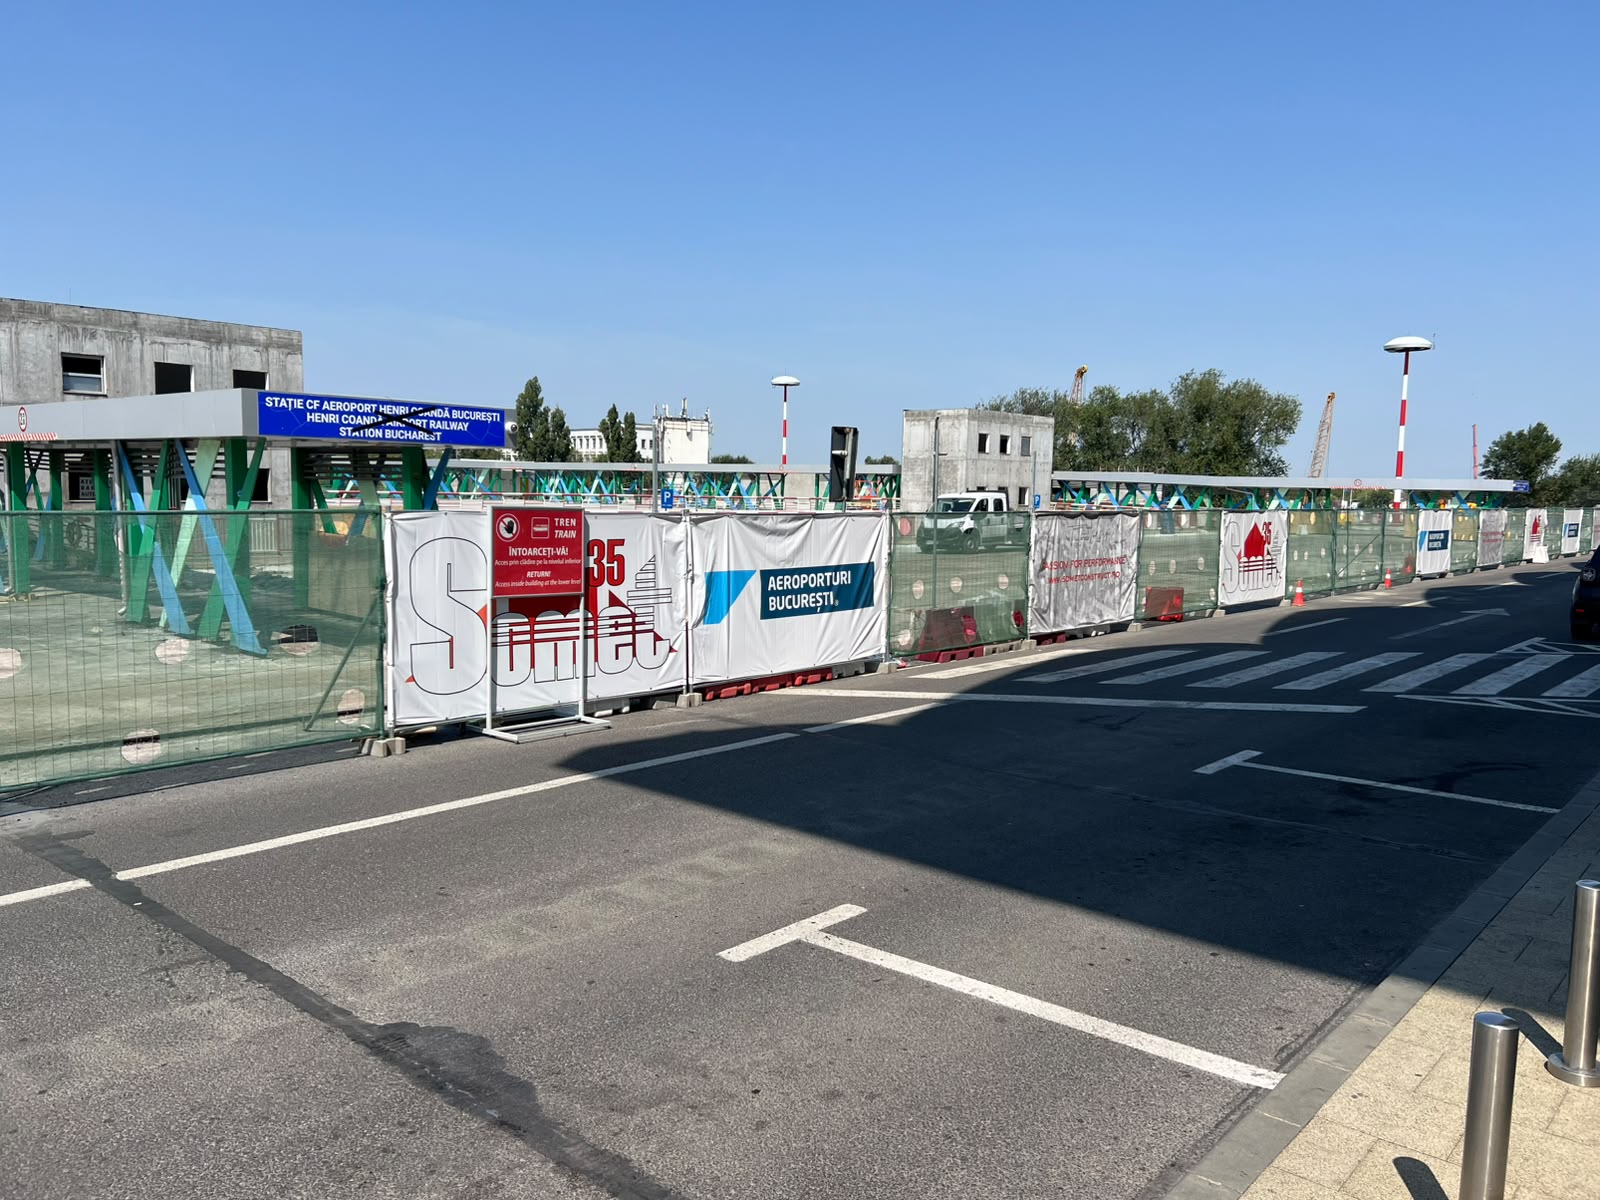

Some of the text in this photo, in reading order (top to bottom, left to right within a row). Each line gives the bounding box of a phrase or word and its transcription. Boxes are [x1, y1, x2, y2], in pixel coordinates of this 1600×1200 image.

[265, 396, 304, 411] STAȚIE
[306, 399, 320, 410] CF
[322, 401, 377, 413] AEROPORT
[379, 404, 409, 415] HENRI
[452, 410, 500, 423] BUCUREȘTI
[306, 412, 339, 424] HENRI
[429, 420, 469, 431] RAILWAY
[385, 428, 442, 441] BUCHAREST
[664, 491, 672, 503] P
[554, 517, 577, 527] TREN
[554, 530, 577, 539] TRAIN
[508, 546, 569, 558] ÎNTOARCEȚI-VĂ!
[587, 538, 626, 588] 35
[767, 570, 852, 591] AEROPORTURI
